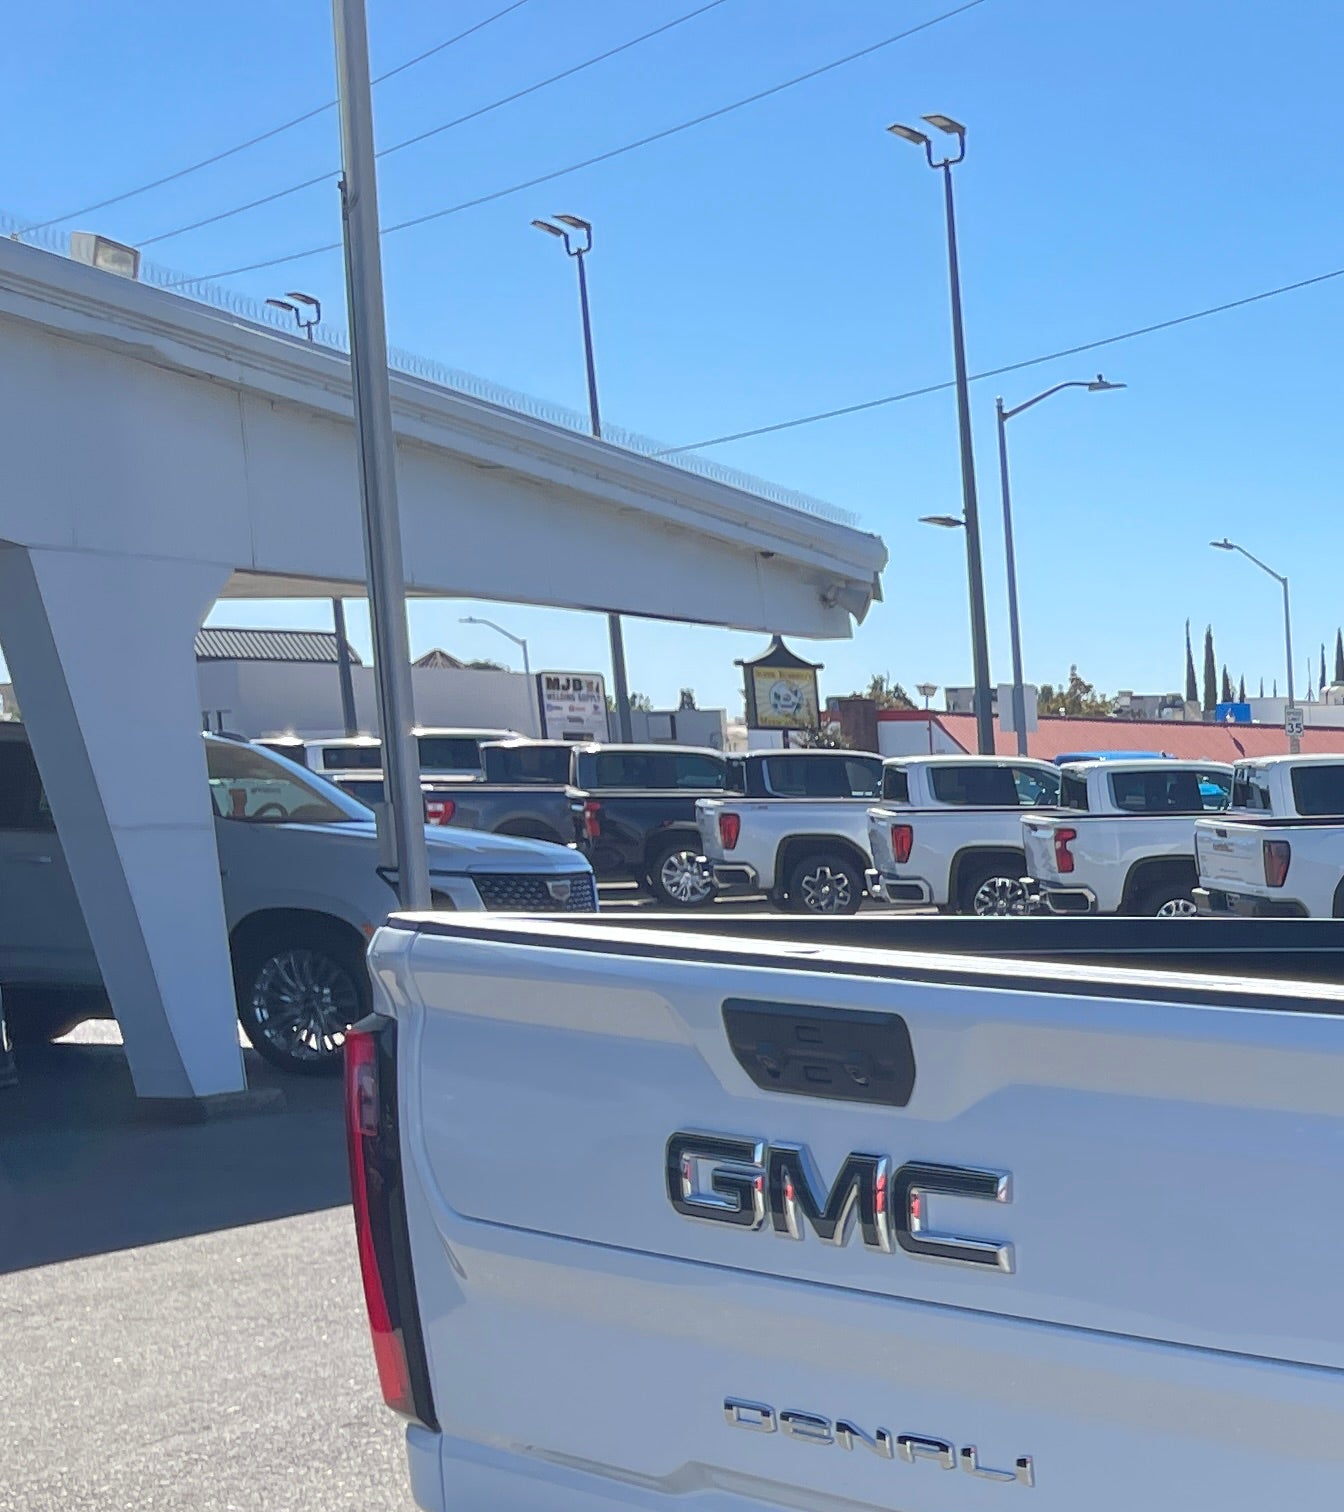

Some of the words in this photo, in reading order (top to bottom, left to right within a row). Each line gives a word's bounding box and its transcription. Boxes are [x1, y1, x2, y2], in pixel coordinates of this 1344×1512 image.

[545, 676, 582, 690] MJB
[1287, 723, 1302, 733] 35
[665, 1128, 1016, 1274] GMC
[723, 1396, 1035, 1488] DENALI
